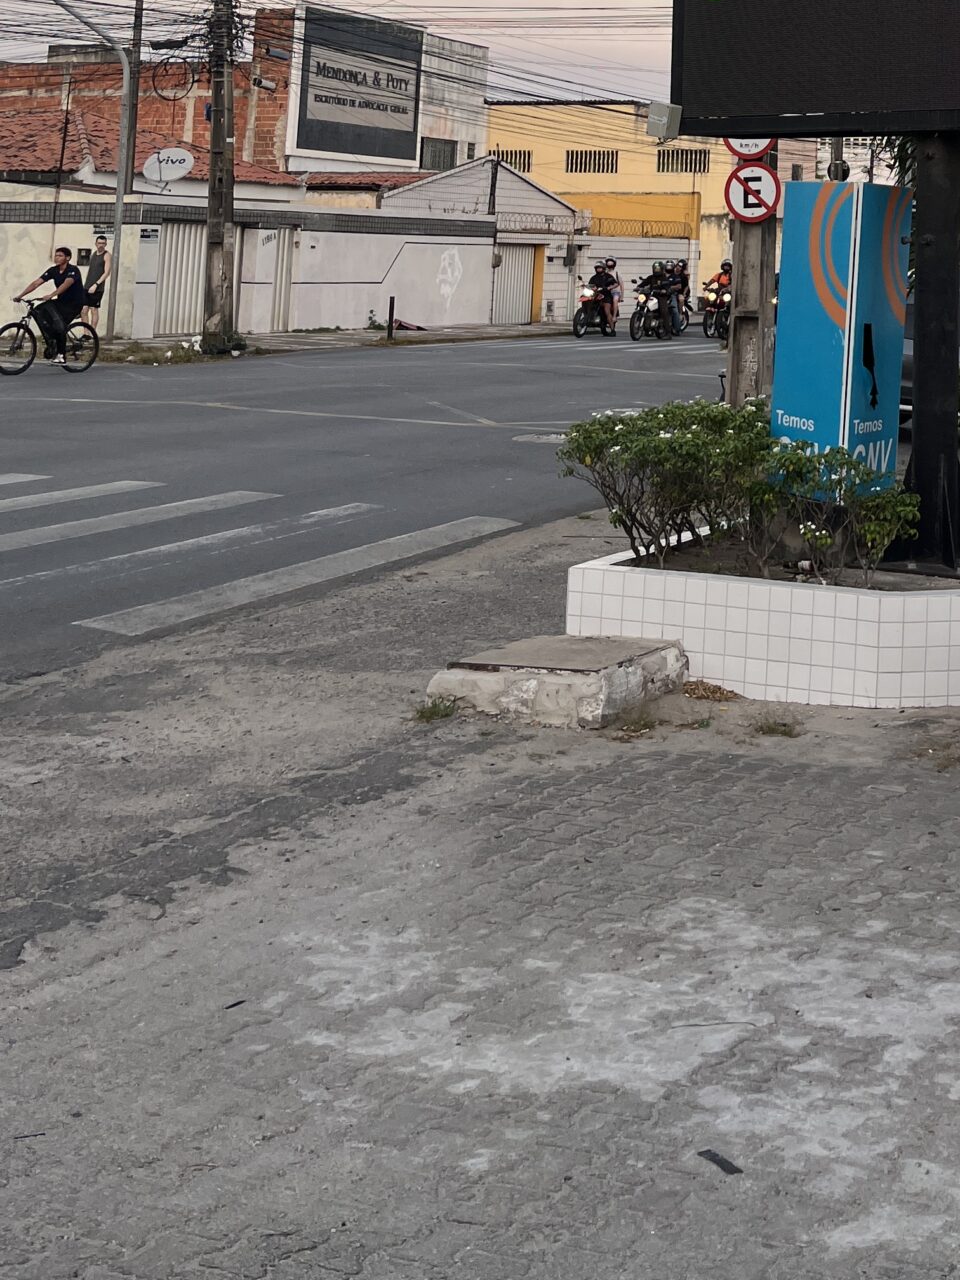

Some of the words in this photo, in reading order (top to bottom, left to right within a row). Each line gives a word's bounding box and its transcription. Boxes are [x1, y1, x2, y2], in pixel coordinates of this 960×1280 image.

[373, 71, 381, 86] &
[349, 100, 356, 108] DE
[159, 156, 186, 165] vivo
[743, 176, 762, 209] E
[776, 409, 815, 432] Temos
[853, 419, 883, 435] Temos
